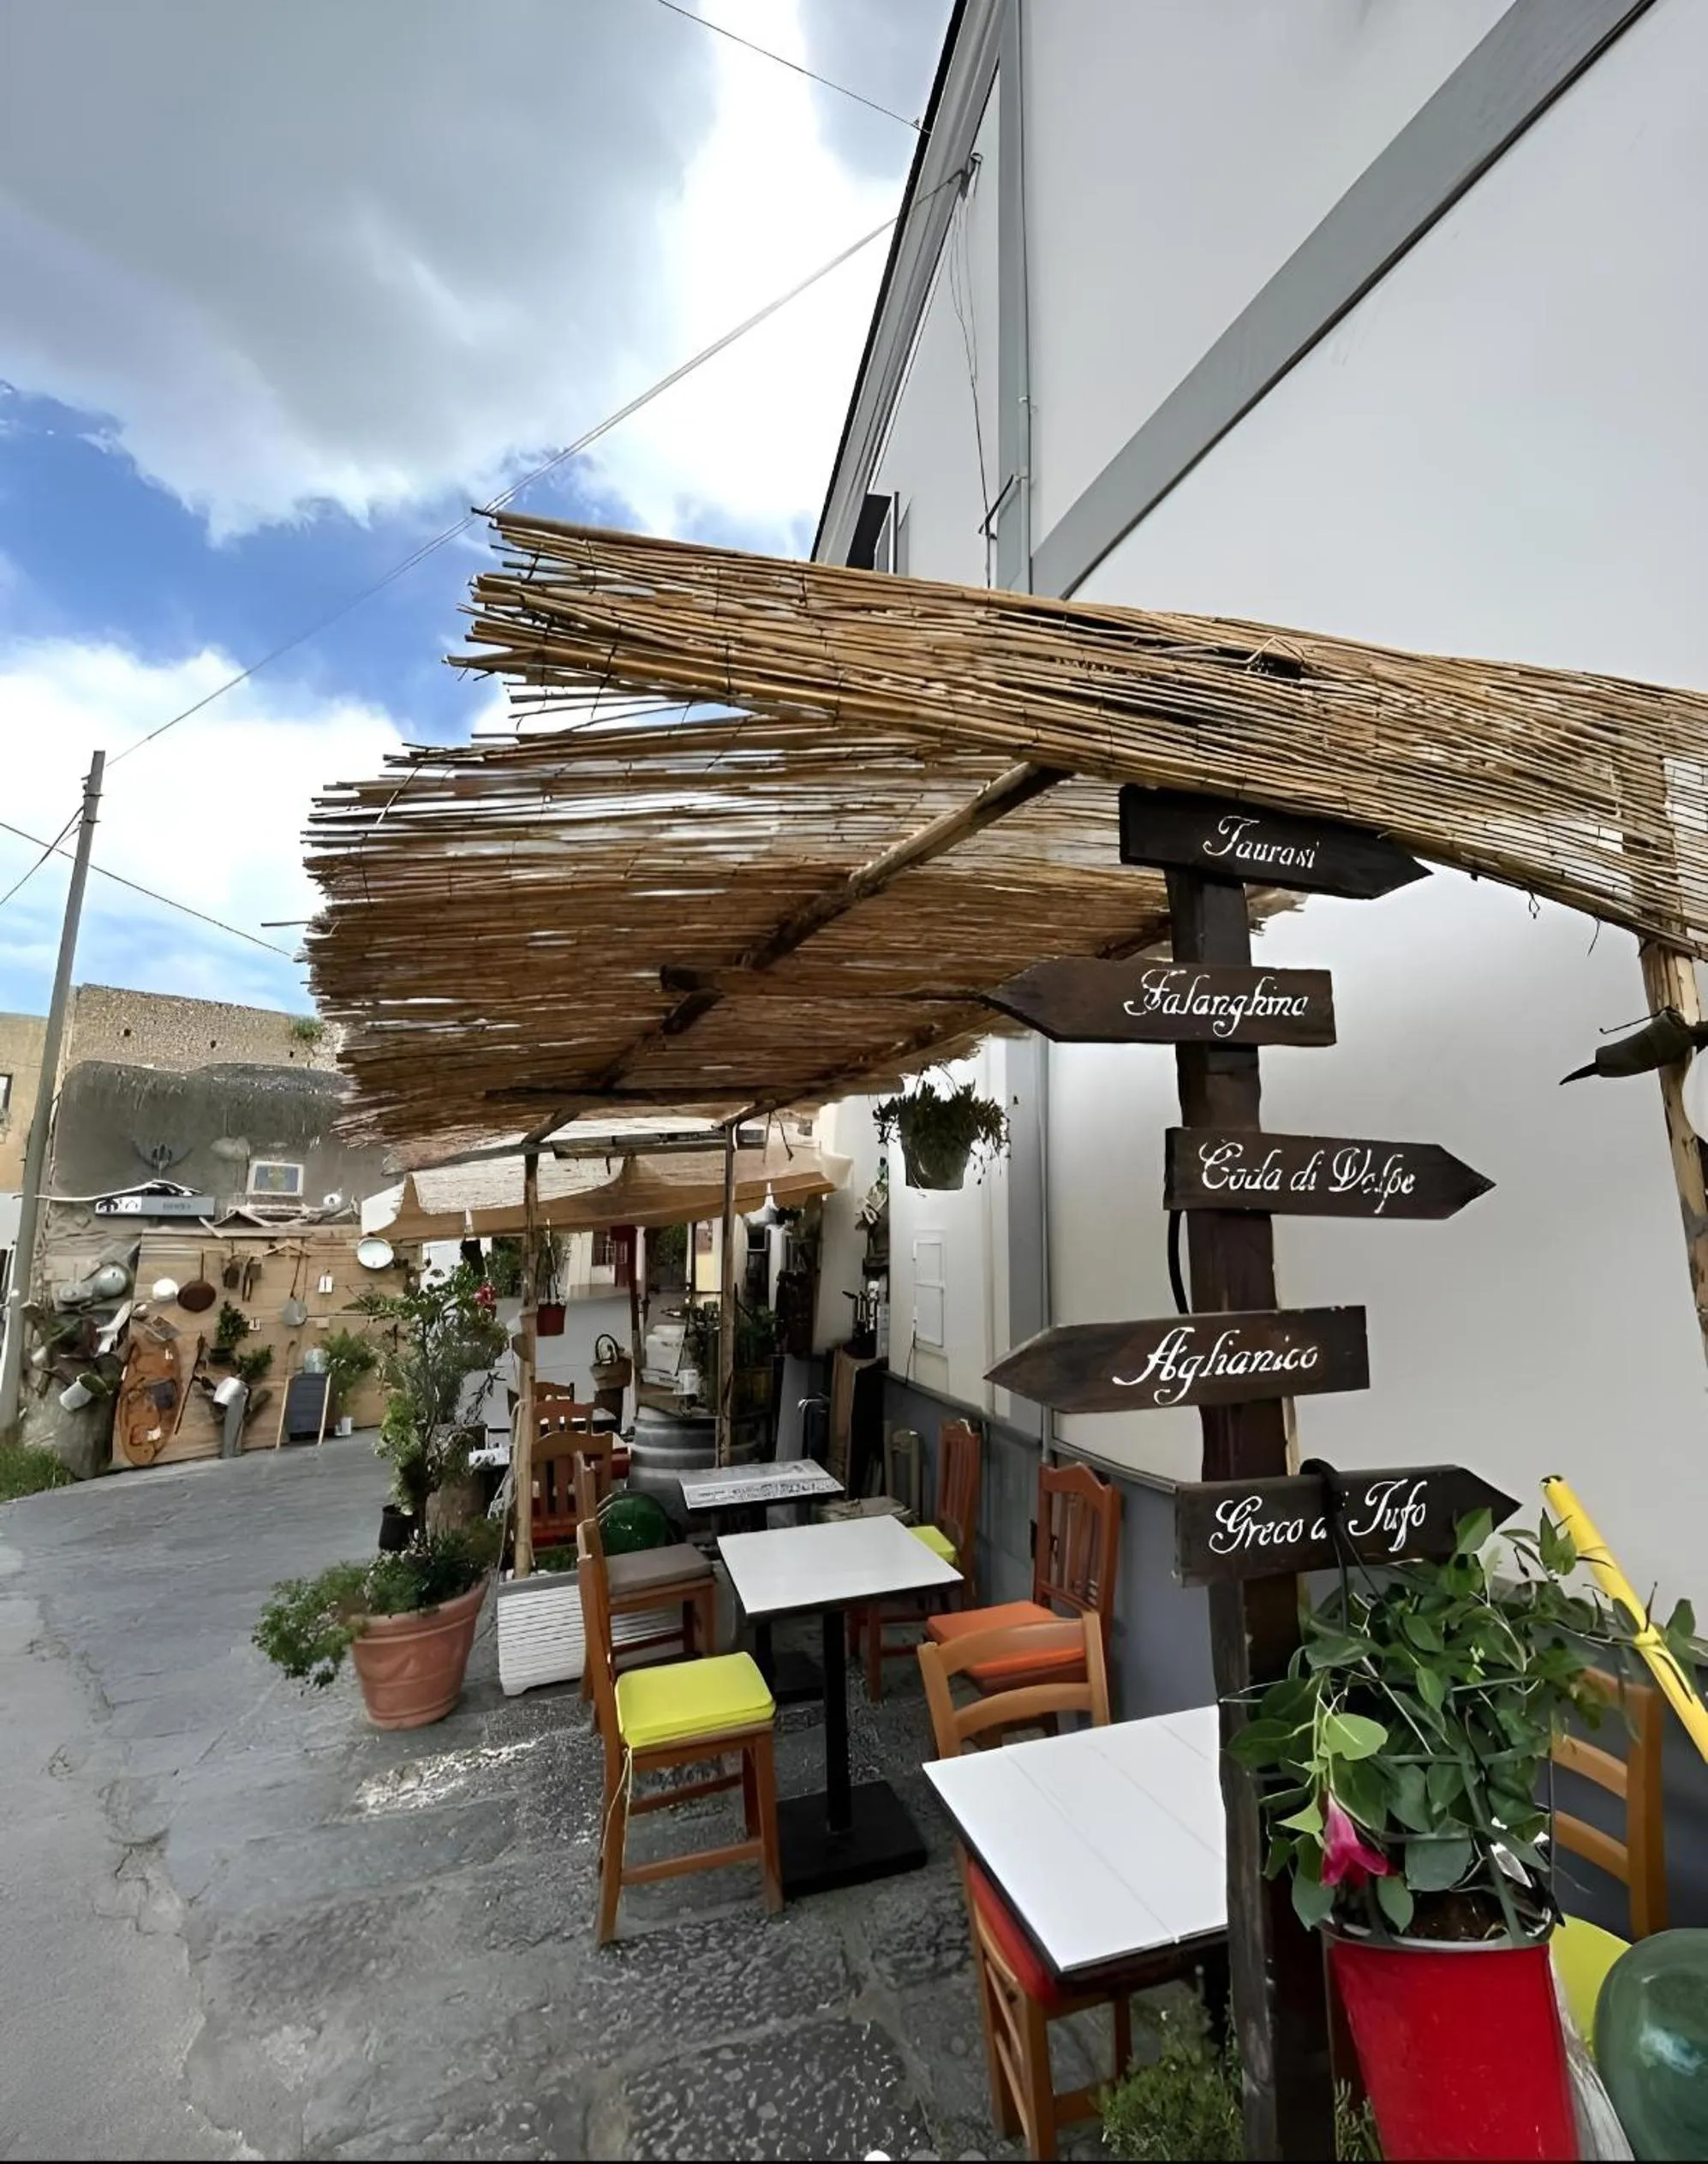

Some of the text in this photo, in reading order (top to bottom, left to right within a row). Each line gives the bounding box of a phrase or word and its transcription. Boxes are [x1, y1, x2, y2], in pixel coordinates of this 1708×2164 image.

[1202, 816, 1320, 869] Taurasi
[1123, 968, 1309, 1037] Falanghina
[1199, 1139, 1415, 1214] Coda di Volpe
[1112, 1326, 1318, 1405] Aglianico
[1209, 1495, 1304, 1554] Greco
[1347, 1478, 1428, 1552] Tufo
